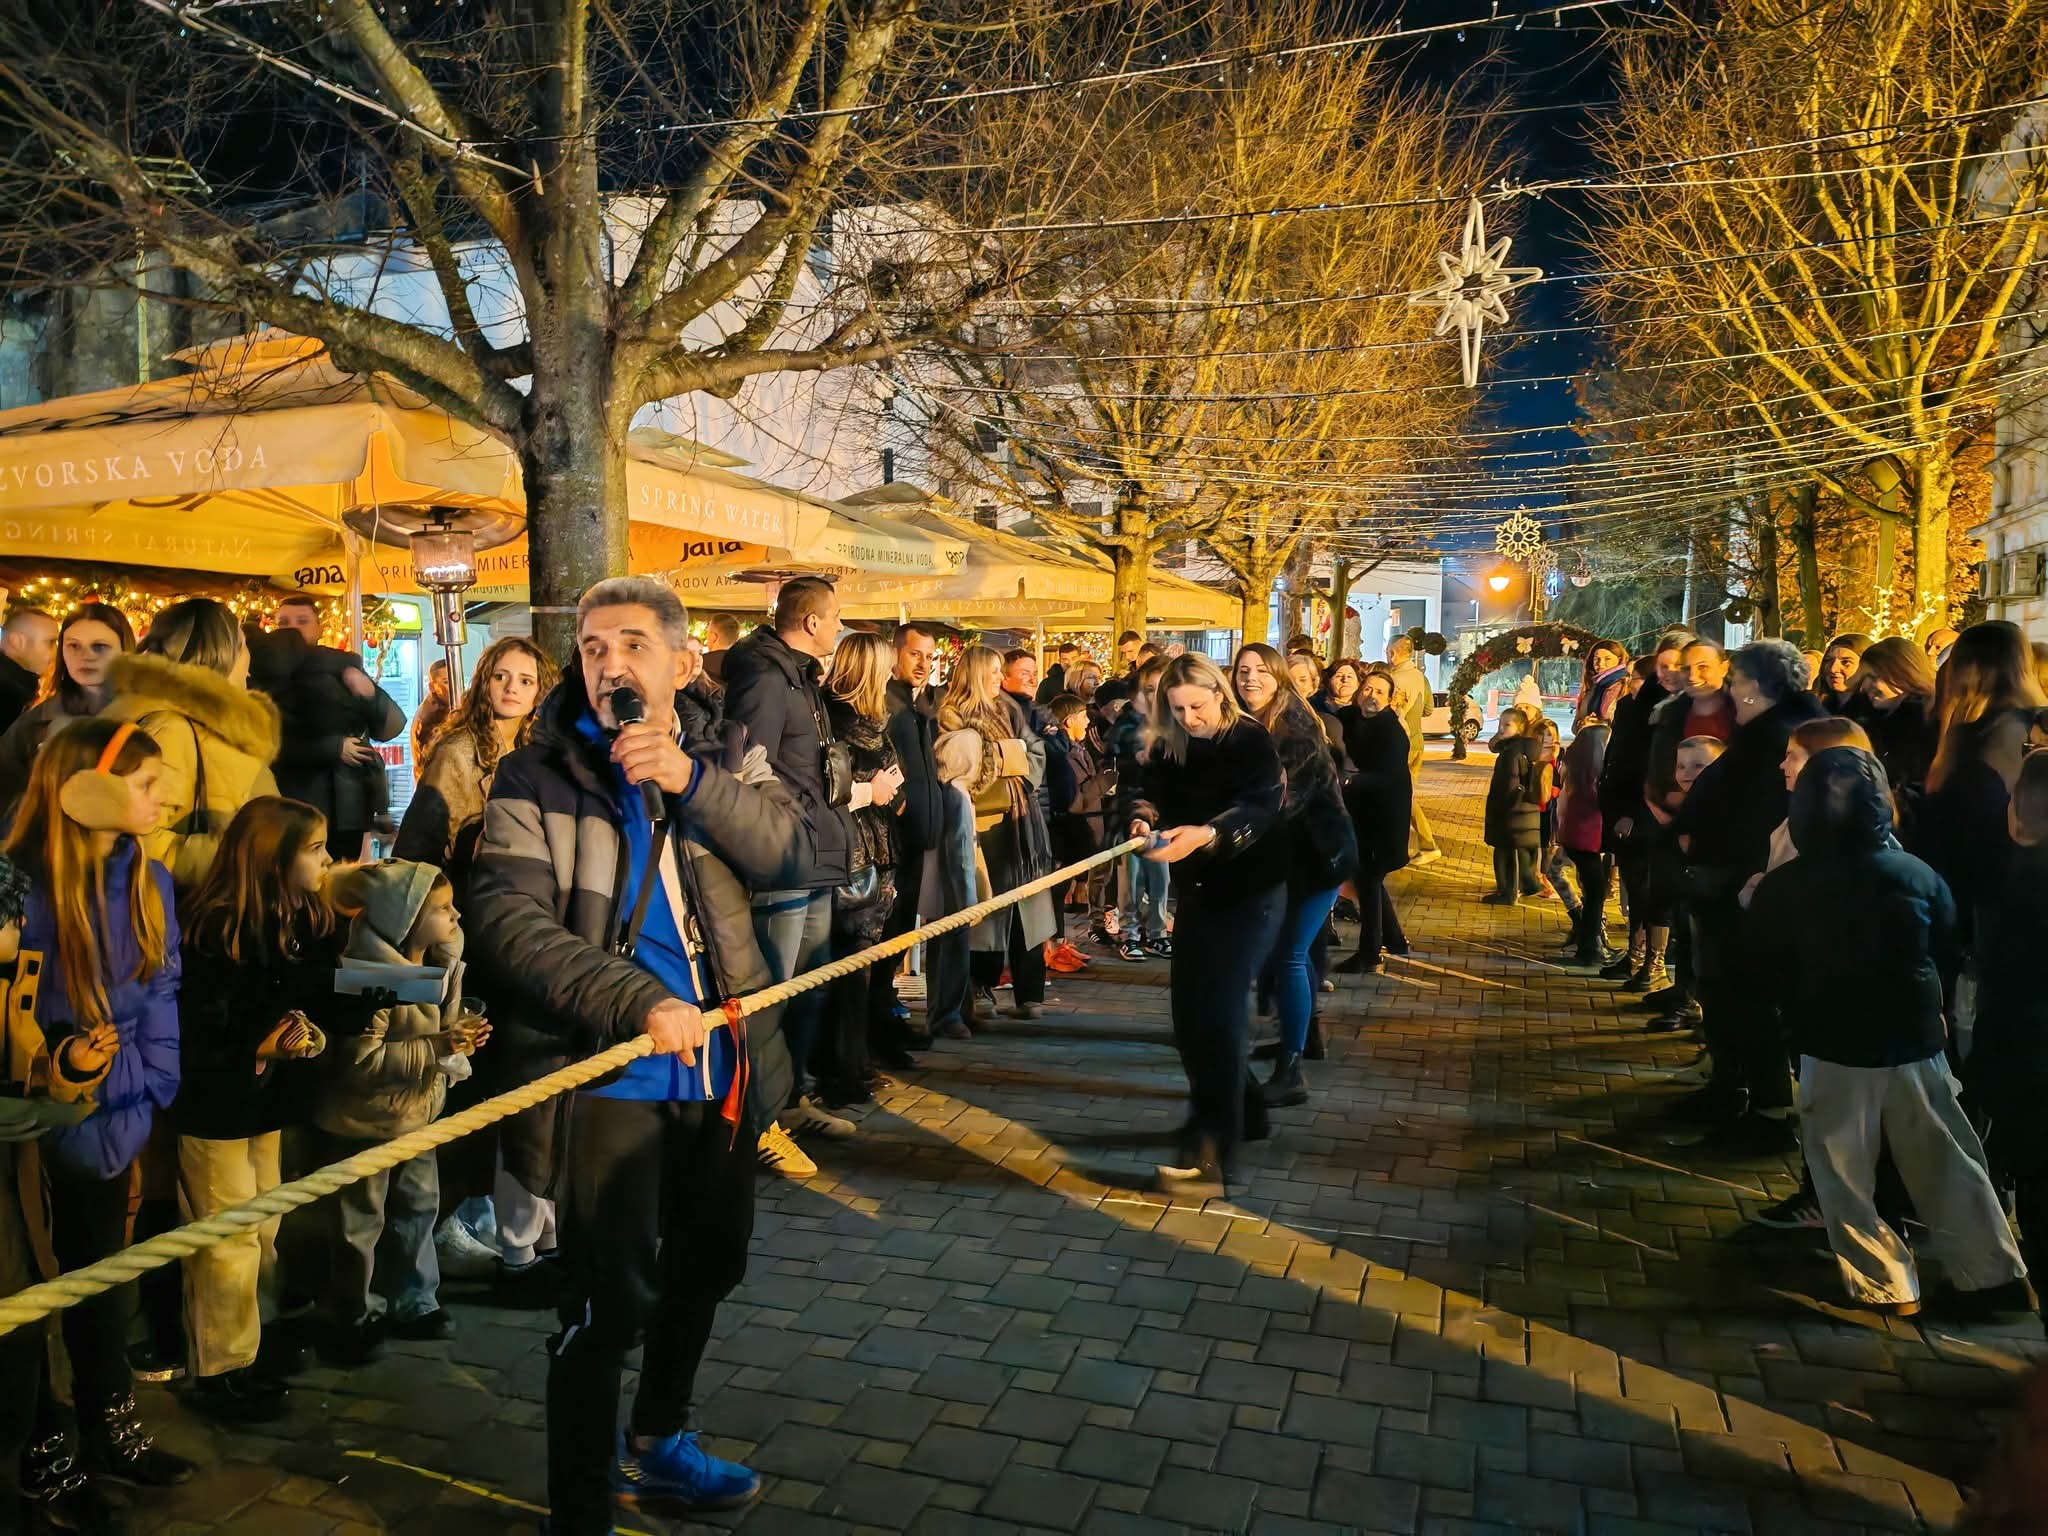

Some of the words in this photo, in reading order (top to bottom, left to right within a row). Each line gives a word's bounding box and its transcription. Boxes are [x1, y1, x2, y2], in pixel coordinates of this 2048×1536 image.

[167, 445, 268, 477] VODA
[641, 484, 716, 519] SPRING
[725, 503, 784, 535] WATER
